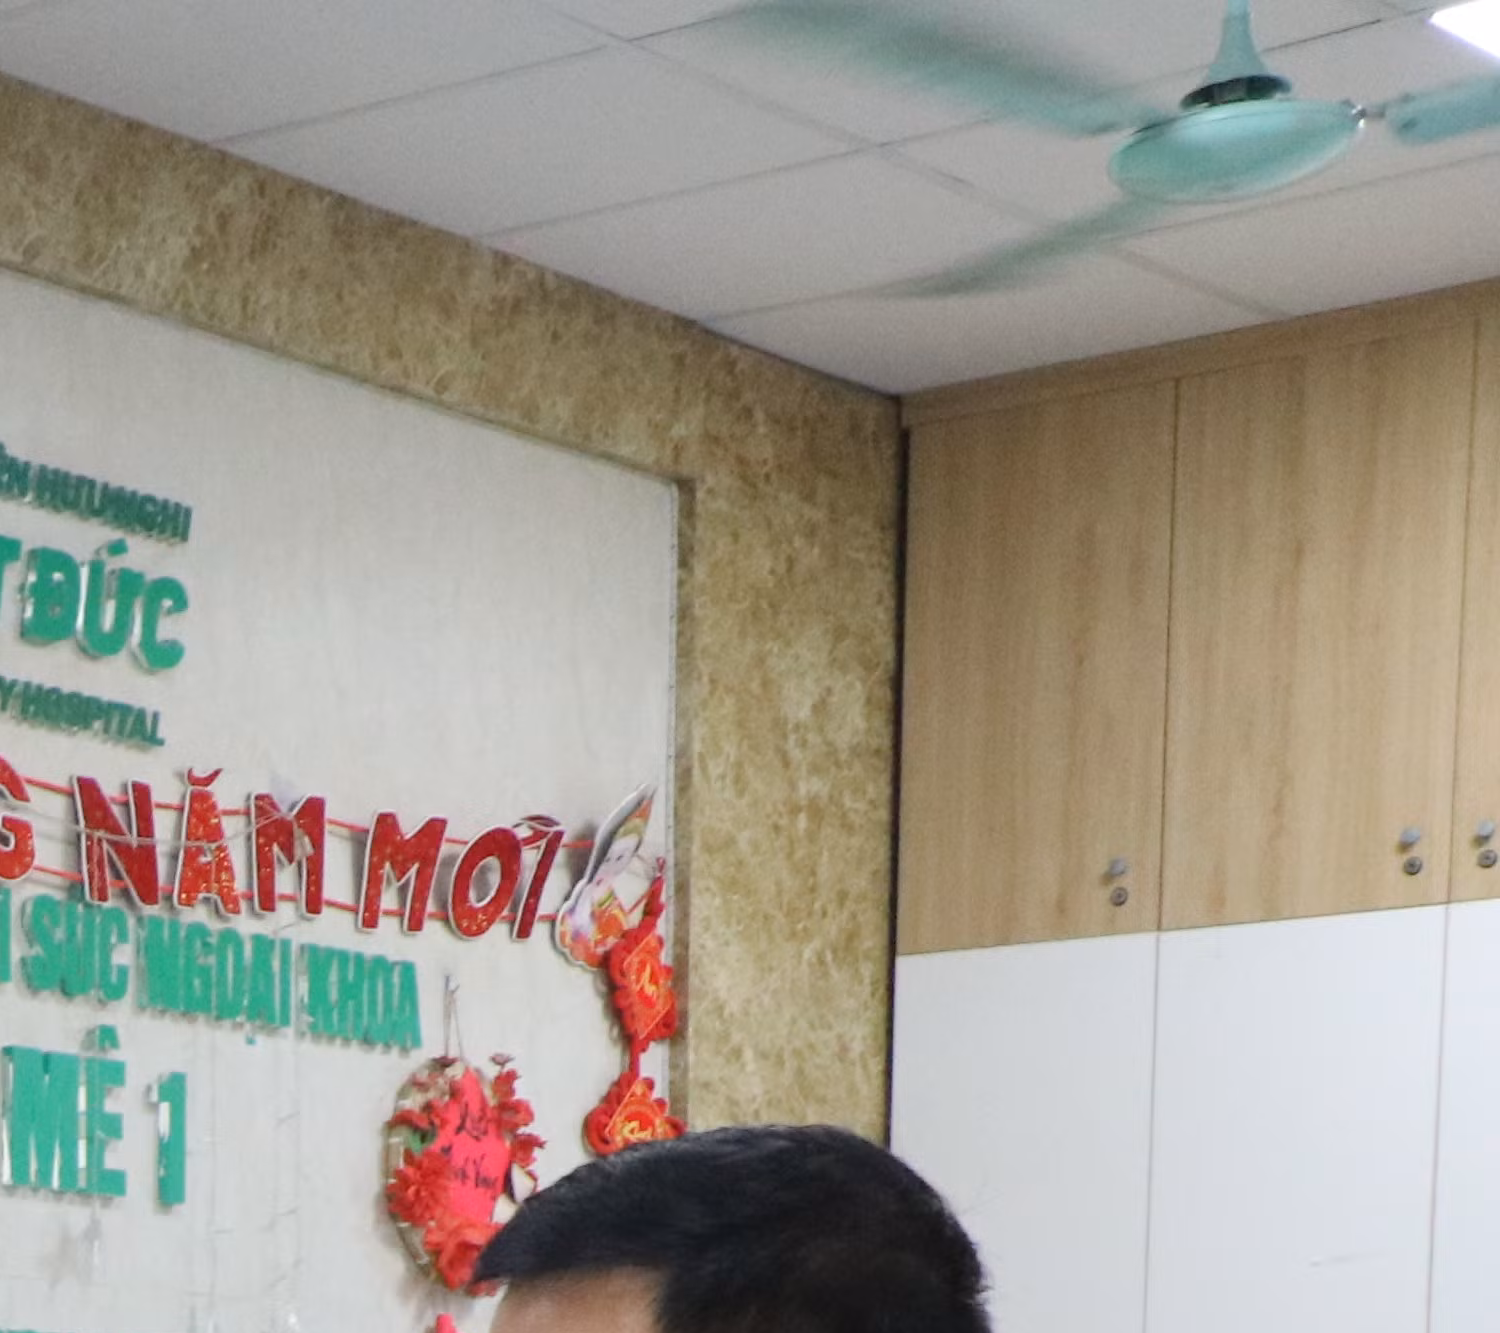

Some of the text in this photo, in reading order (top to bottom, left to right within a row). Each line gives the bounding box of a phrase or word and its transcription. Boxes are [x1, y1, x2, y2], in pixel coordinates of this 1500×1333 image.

[19, 537, 189, 672] ĐỨC
[73, 766, 327, 917] NĂM
[2, 1024, 127, 1197] MÊ
[147, 1071, 188, 1205] 1
